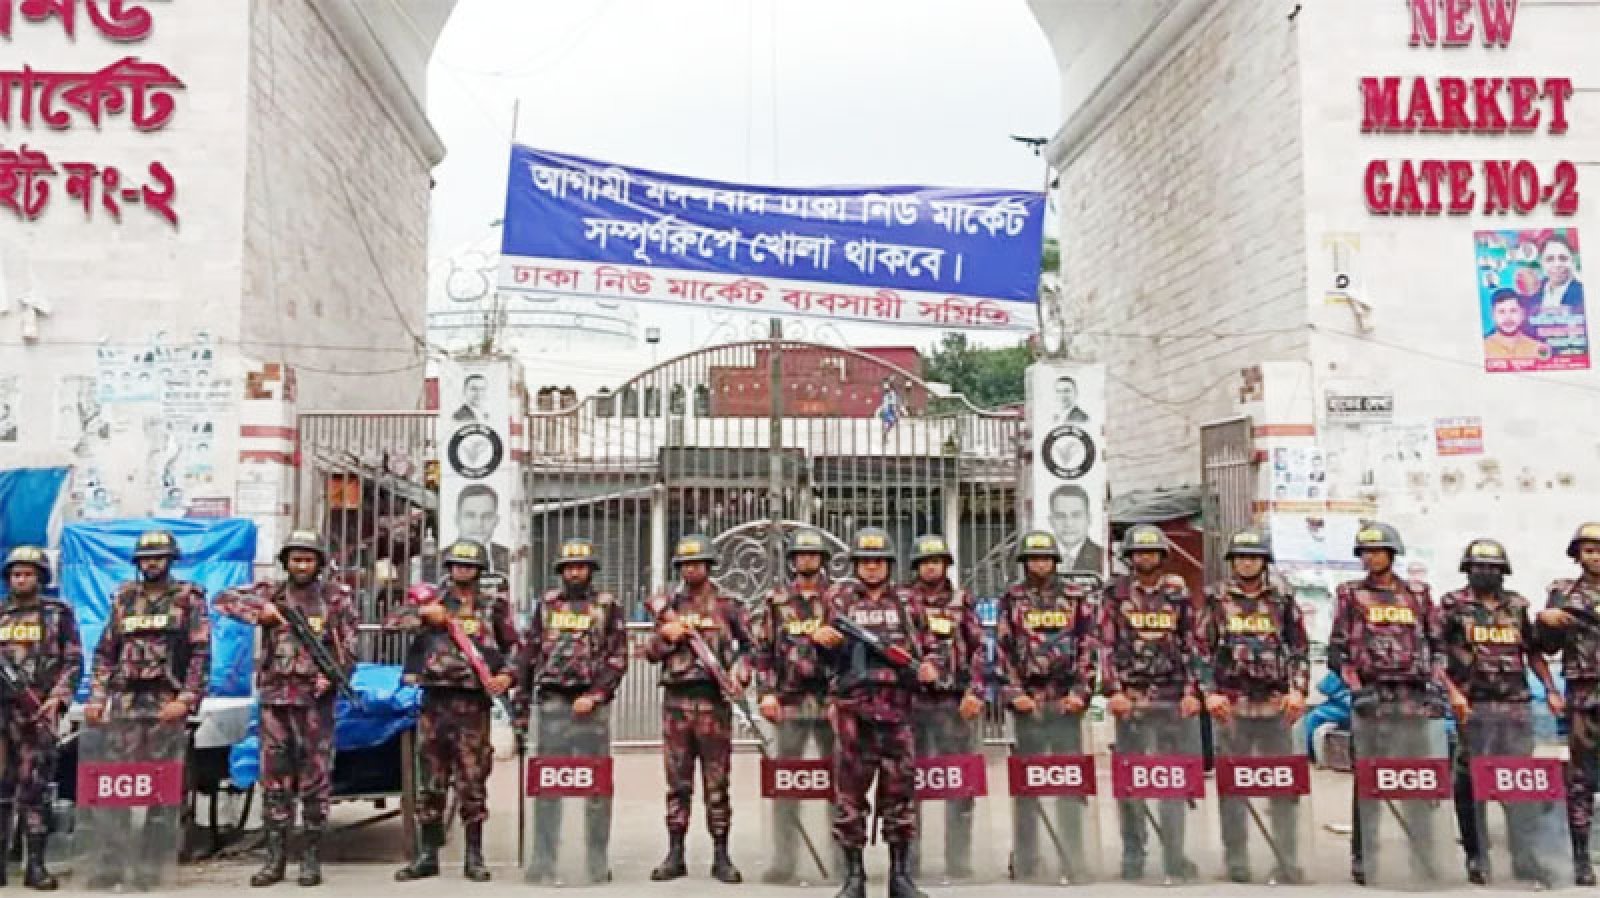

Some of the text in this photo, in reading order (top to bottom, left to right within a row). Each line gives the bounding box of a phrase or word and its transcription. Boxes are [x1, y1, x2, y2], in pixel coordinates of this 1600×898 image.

[1407, 0, 1518, 48] NEW
[1359, 76, 1573, 134] MARKET
[60, 161, 179, 231] নং-২
[1364, 160, 1579, 215] GATE NO-2
[859, 193, 921, 227] নিউ
[930, 196, 1030, 237] মার্কেট
[750, 232, 835, 270] খোলা
[844, 237, 947, 281] থাকবে
[511, 265, 583, 290] ঢাকা
[594, 266, 655, 294] নিউ
[666, 277, 770, 304] মার্কেট
[98, 774, 152, 798] BGB
[540, 767, 593, 787] BGB
[774, 769, 831, 790] BGB
[1026, 766, 1083, 787] BGB
[1133, 766, 1186, 788] BGB
[1234, 766, 1293, 788] BGB
[1377, 769, 1437, 790] BGB
[1496, 768, 1549, 790] BGB
